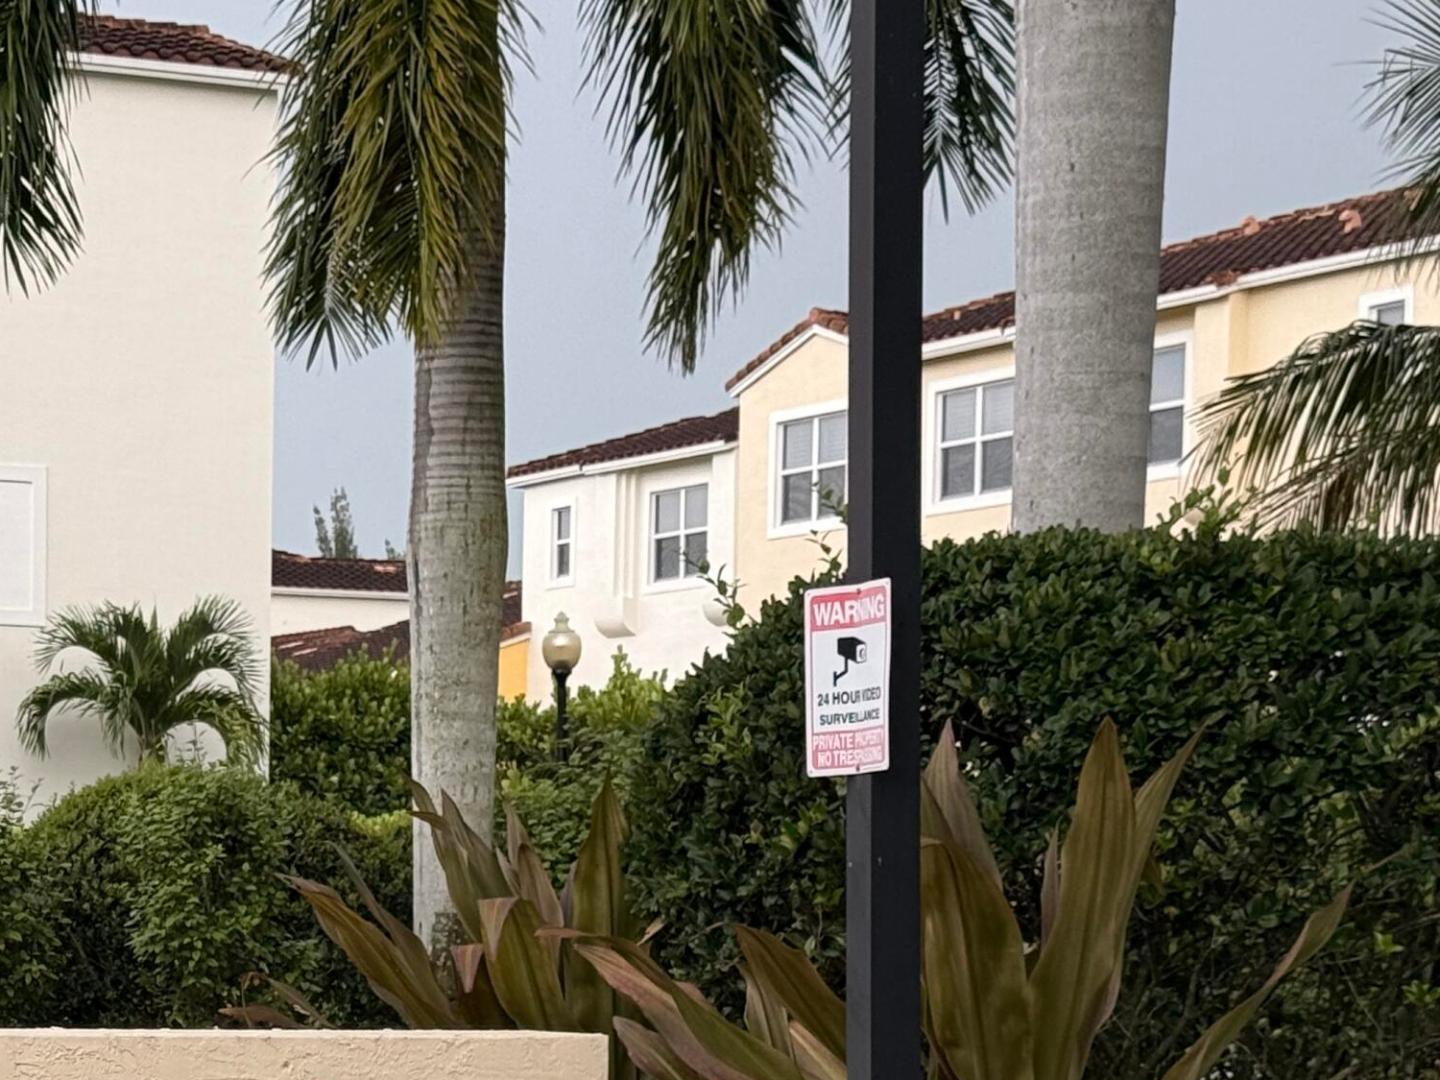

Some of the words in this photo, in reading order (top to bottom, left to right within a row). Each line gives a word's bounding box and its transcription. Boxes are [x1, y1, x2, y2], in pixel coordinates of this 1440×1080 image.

[812, 593, 885, 626] WARNING
[817, 693, 830, 707] 24
[812, 732, 855, 751] PRIVATE
[817, 750, 832, 768] NO
